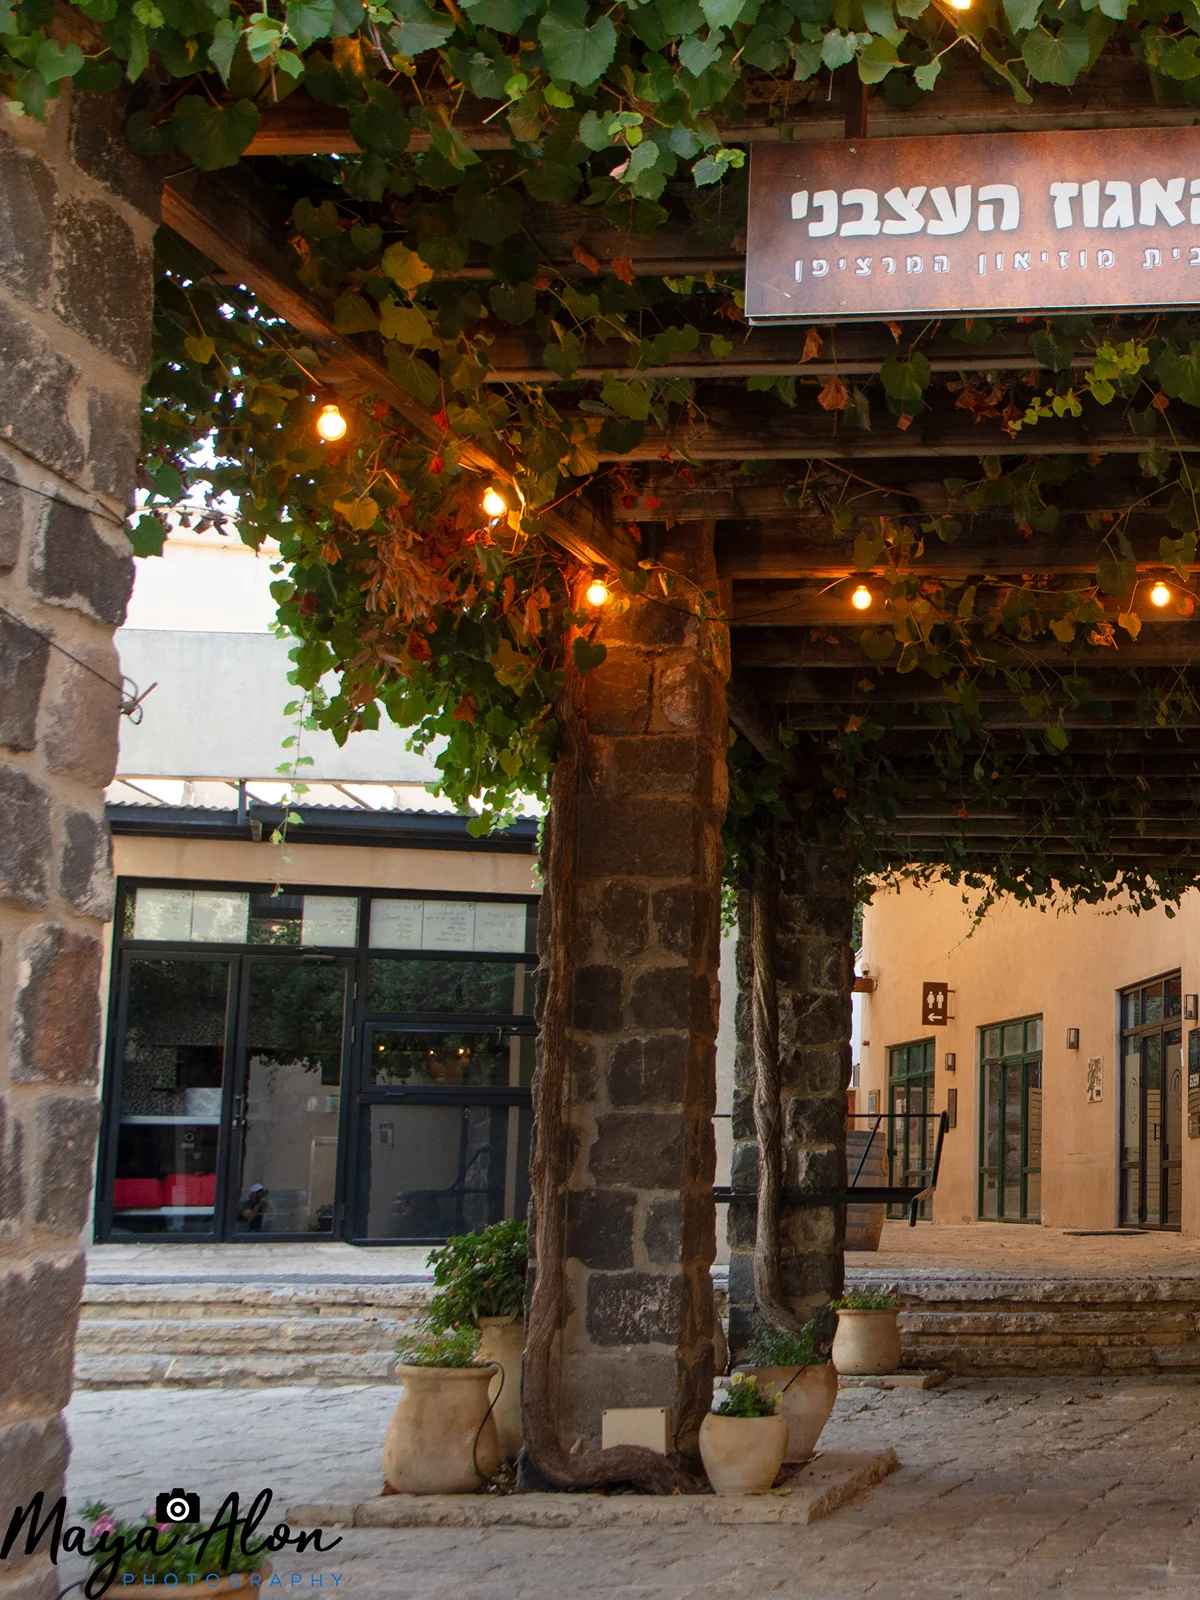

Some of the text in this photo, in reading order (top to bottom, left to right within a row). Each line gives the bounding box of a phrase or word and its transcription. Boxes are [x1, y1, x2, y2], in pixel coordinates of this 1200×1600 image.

[791, 184, 1019, 237] העצבני
[793, 253, 950, 283] המרציפן
[977, 248, 1116, 276] מוזיאון
